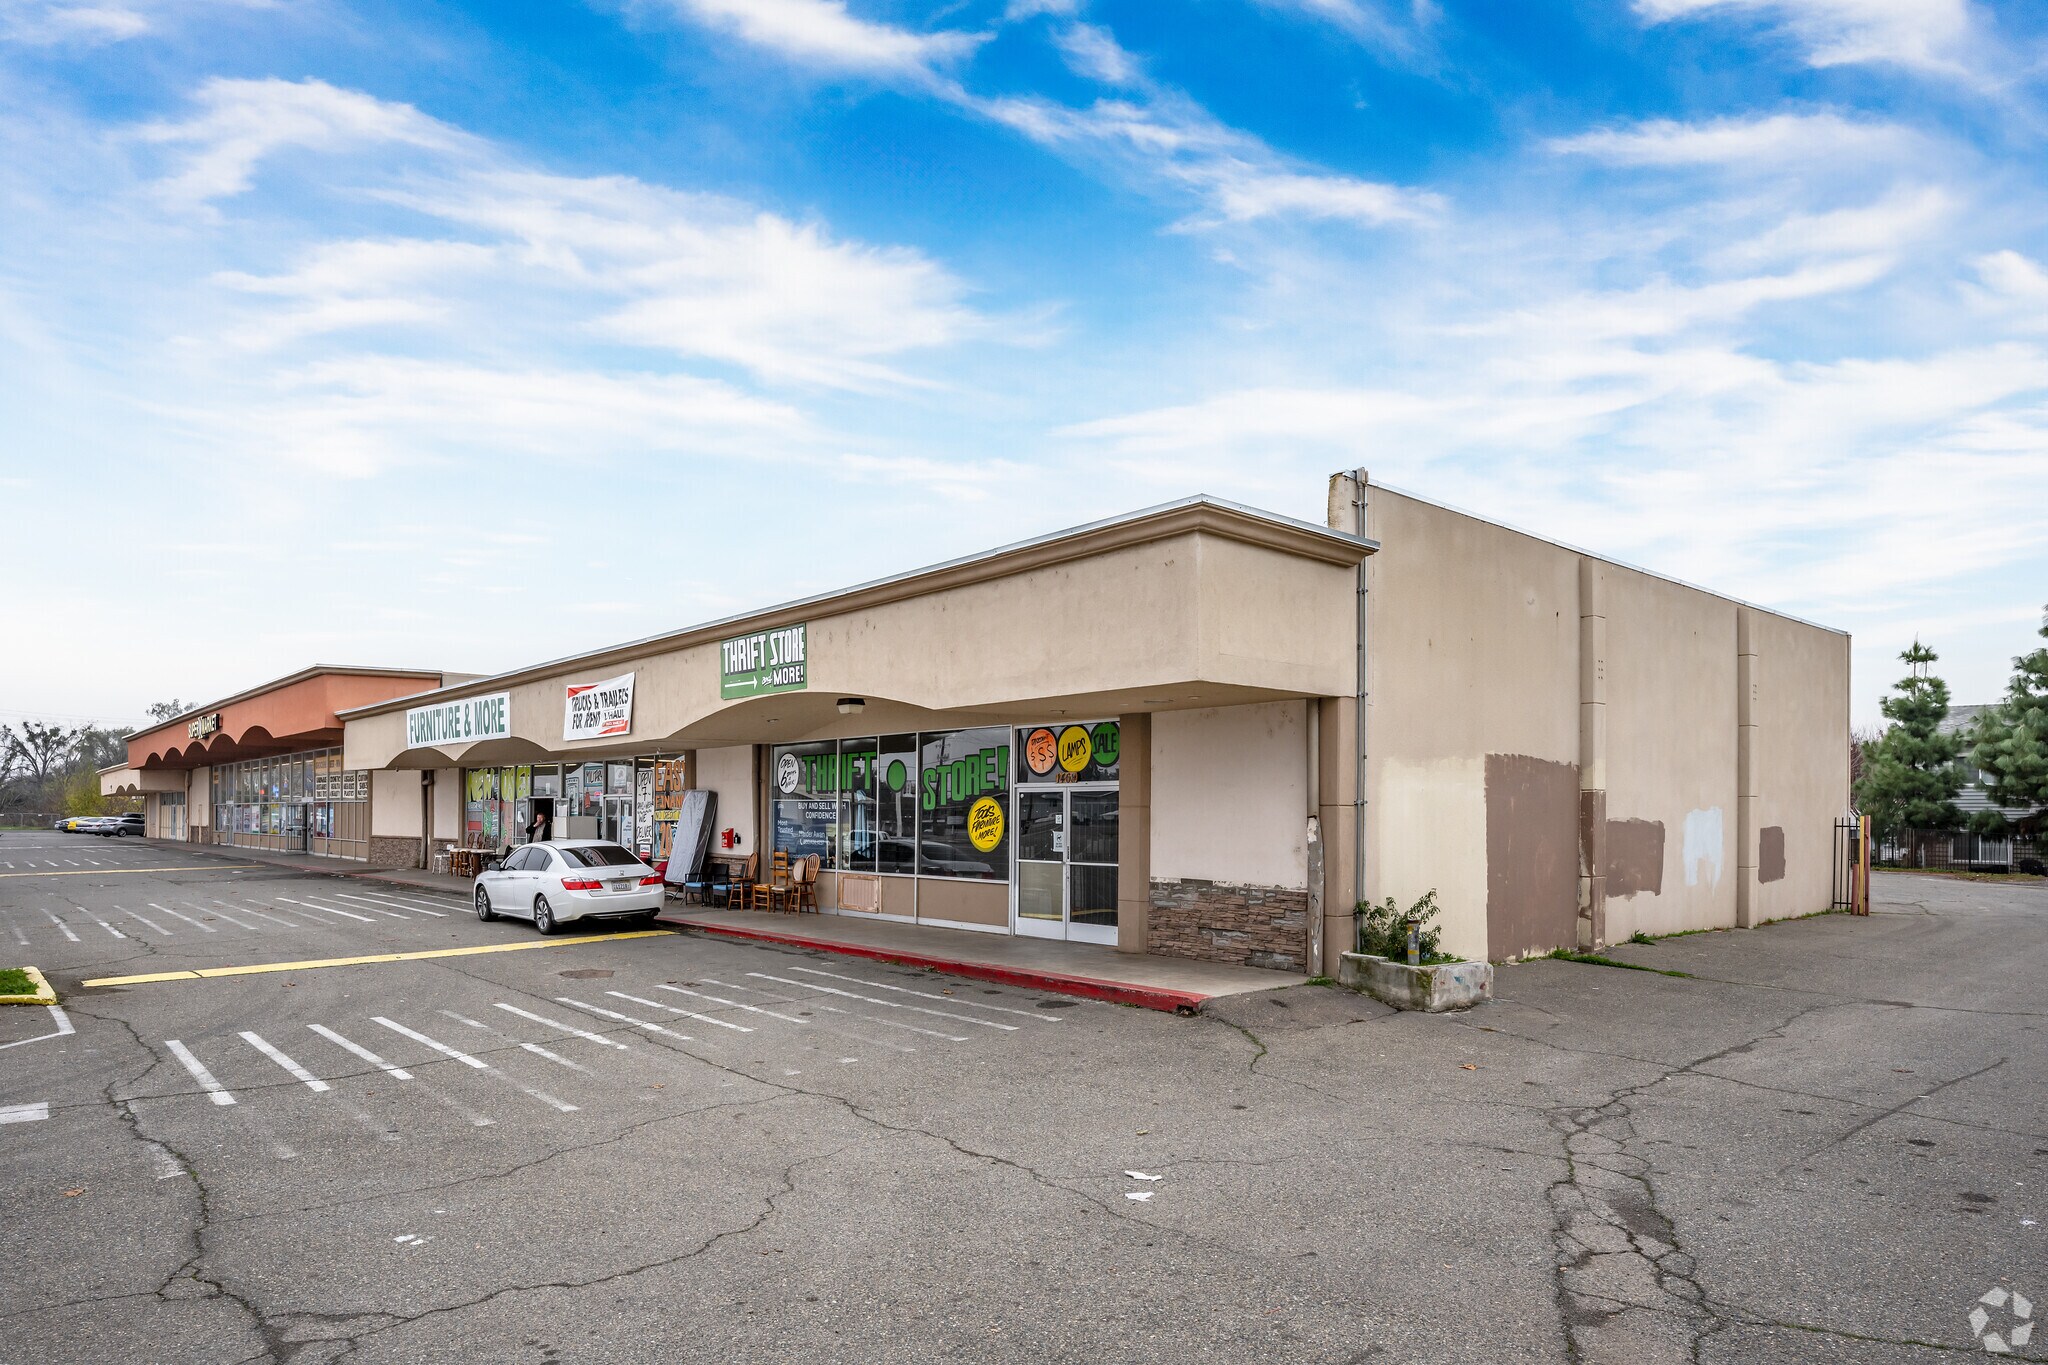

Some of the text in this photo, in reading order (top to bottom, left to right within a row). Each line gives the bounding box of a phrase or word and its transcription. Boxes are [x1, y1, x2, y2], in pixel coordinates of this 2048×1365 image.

[723, 626, 805, 675] THRIFT STORE
[773, 665, 804, 687] MORE!
[572, 687, 629, 712] TRUCKS & TRAILERS
[409, 697, 505, 744] FURNITURE & MORE
[572, 712, 583, 730] FOR
[583, 711, 601, 728] RENT
[1062, 737, 1086, 762] LAMPS
[1092, 732, 1117, 755] SALE
[780, 758, 796, 769] OPEN
[467, 768, 495, 802] NEW
[637, 772, 653, 787] OPEN
[780, 770, 787, 787] 6
[801, 745, 1010, 811] THRIFT STORE!
[798, 802, 807, 810] BUY
[808, 802, 819, 810] AND
[819, 802, 831, 810] SELL
[973, 804, 995, 820] TOOLS
[638, 813, 647, 823] WE
[971, 815, 1001, 833] FURNITURE
[637, 825, 652, 839] DELIVER
